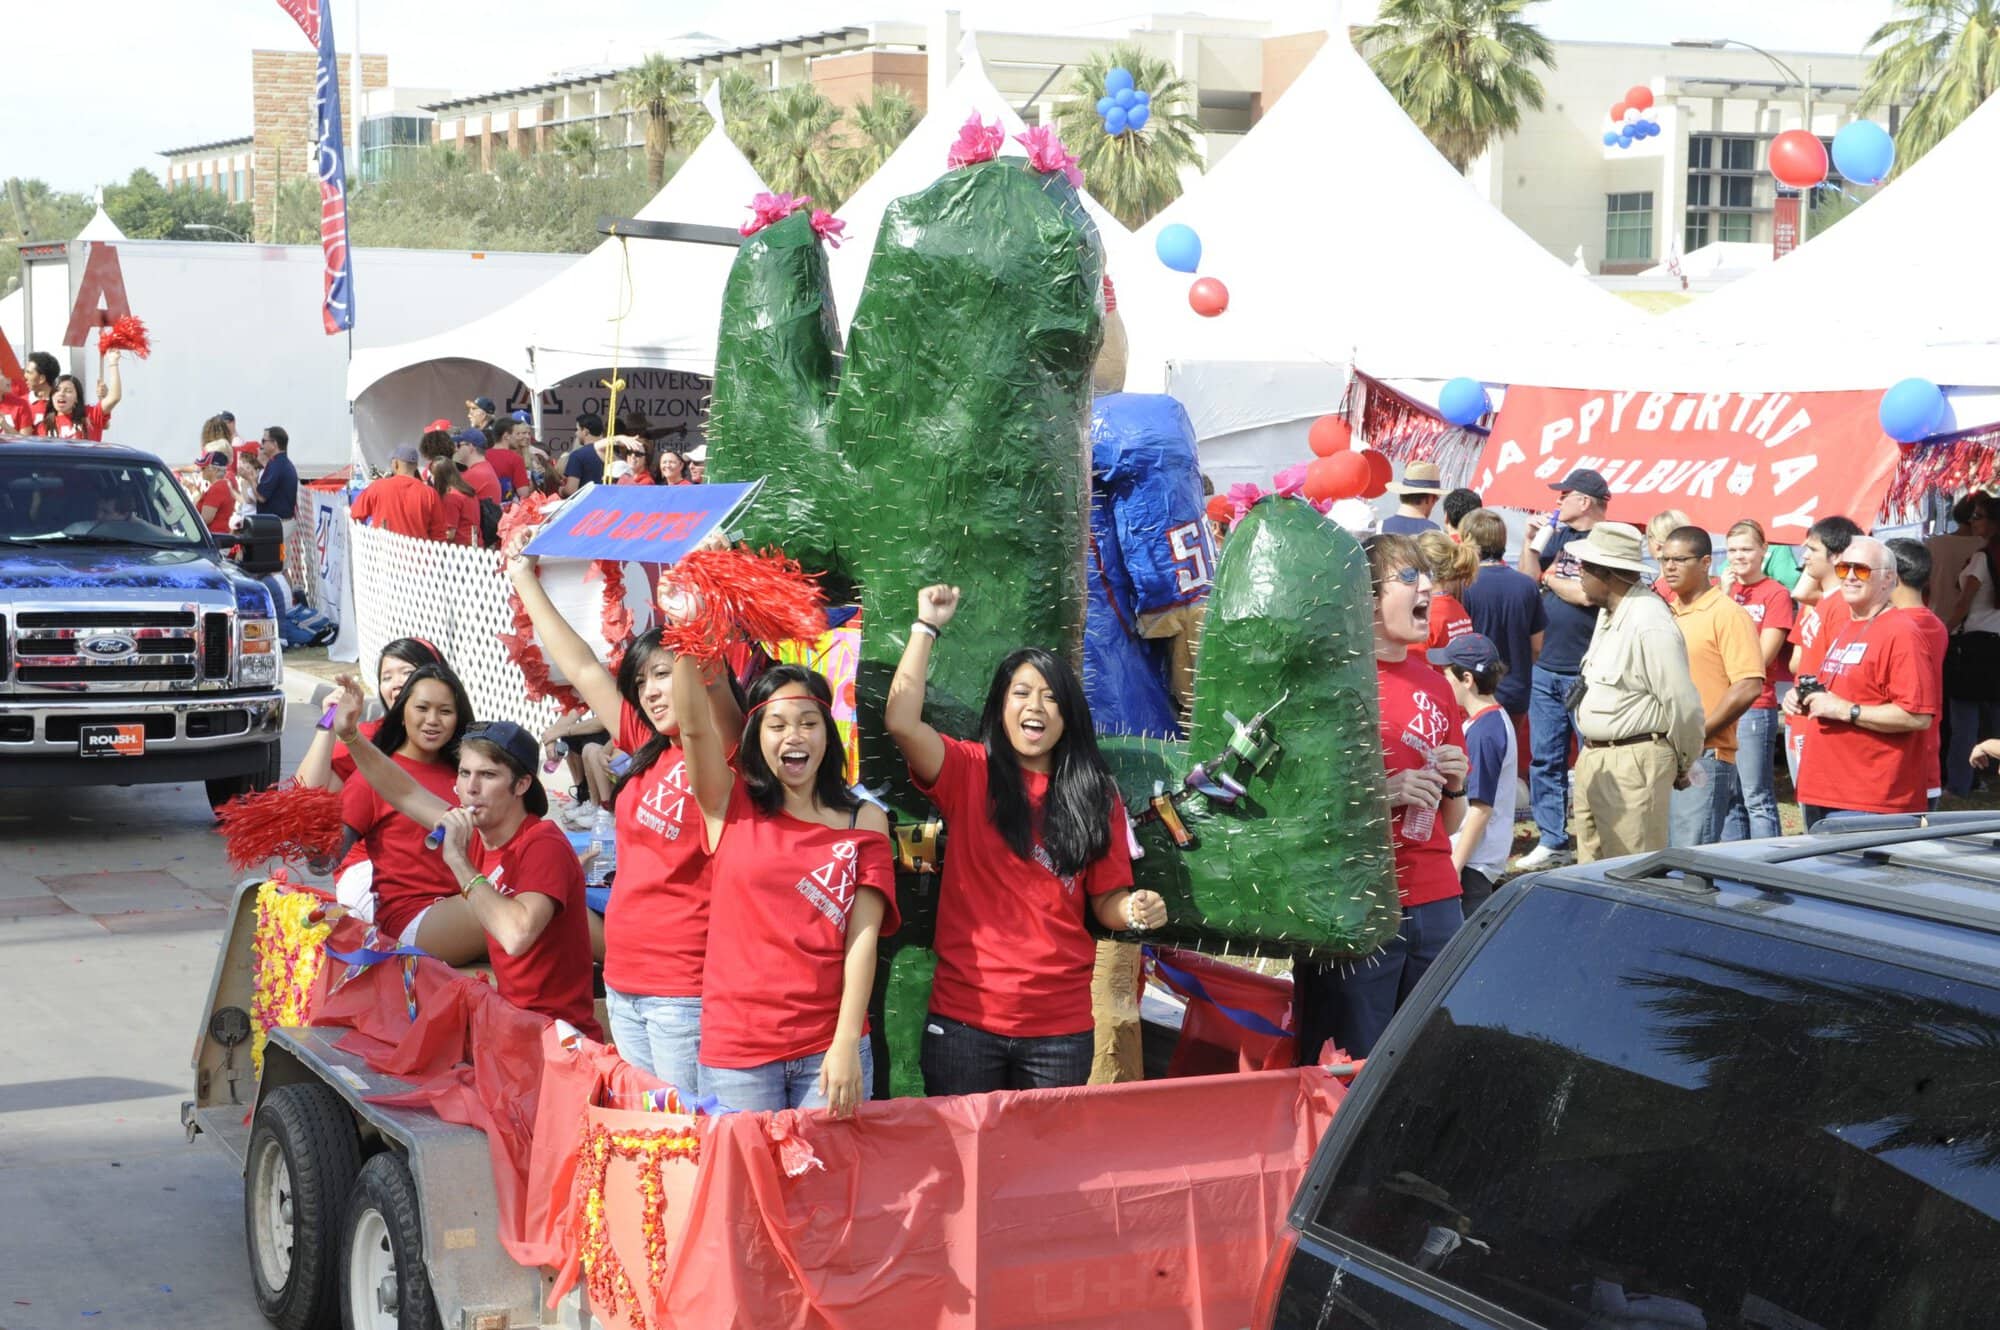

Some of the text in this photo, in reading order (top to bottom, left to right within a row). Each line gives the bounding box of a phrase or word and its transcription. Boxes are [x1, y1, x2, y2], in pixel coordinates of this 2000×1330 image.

[620, 372, 713, 390] NIVERSI
[582, 397, 609, 417] OF
[567, 509, 709, 542] GO CATS!
[96, 640, 122, 652] Ford
